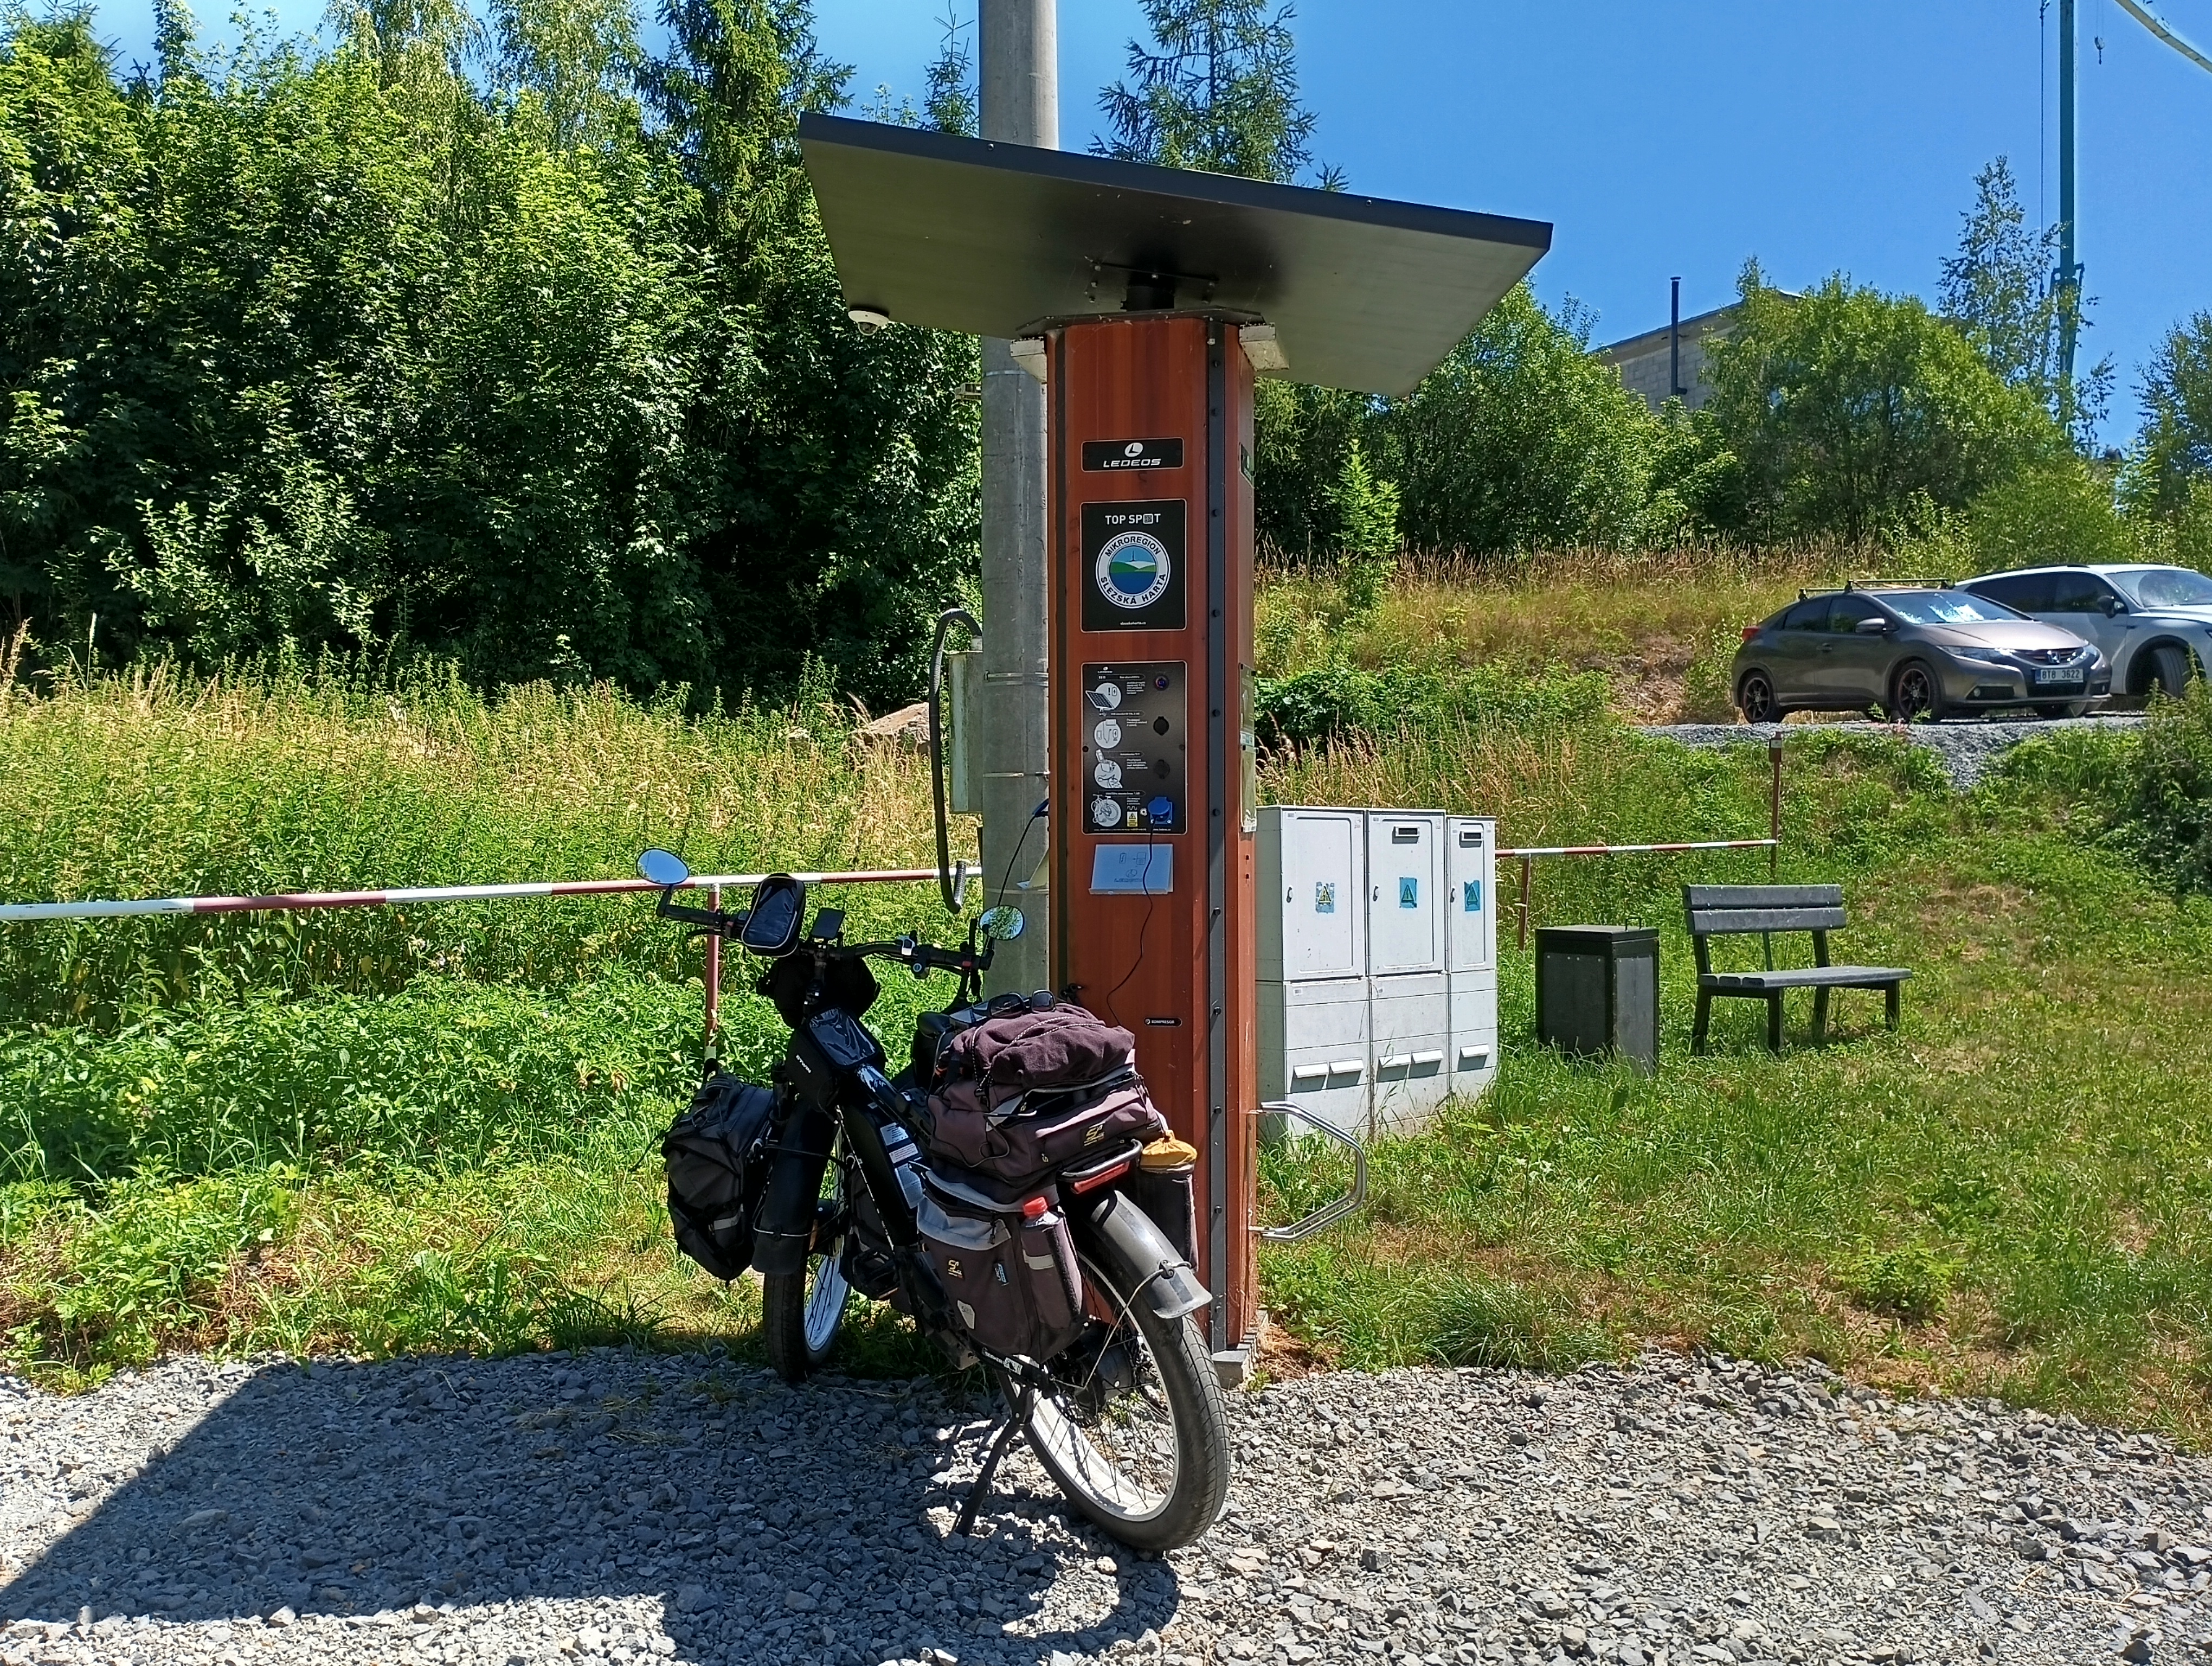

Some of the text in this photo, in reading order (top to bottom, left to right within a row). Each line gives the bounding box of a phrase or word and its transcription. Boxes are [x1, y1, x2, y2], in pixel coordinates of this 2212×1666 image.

[1103, 458, 1161, 468] LEDEOS
[1104, 515, 1126, 525] TOP
[1104, 536, 1161, 557] MIKROREGION
[1101, 574, 1166, 604] SLEZSKÁ HARTA
[2042, 669, 2080, 680] 8T8 3622
